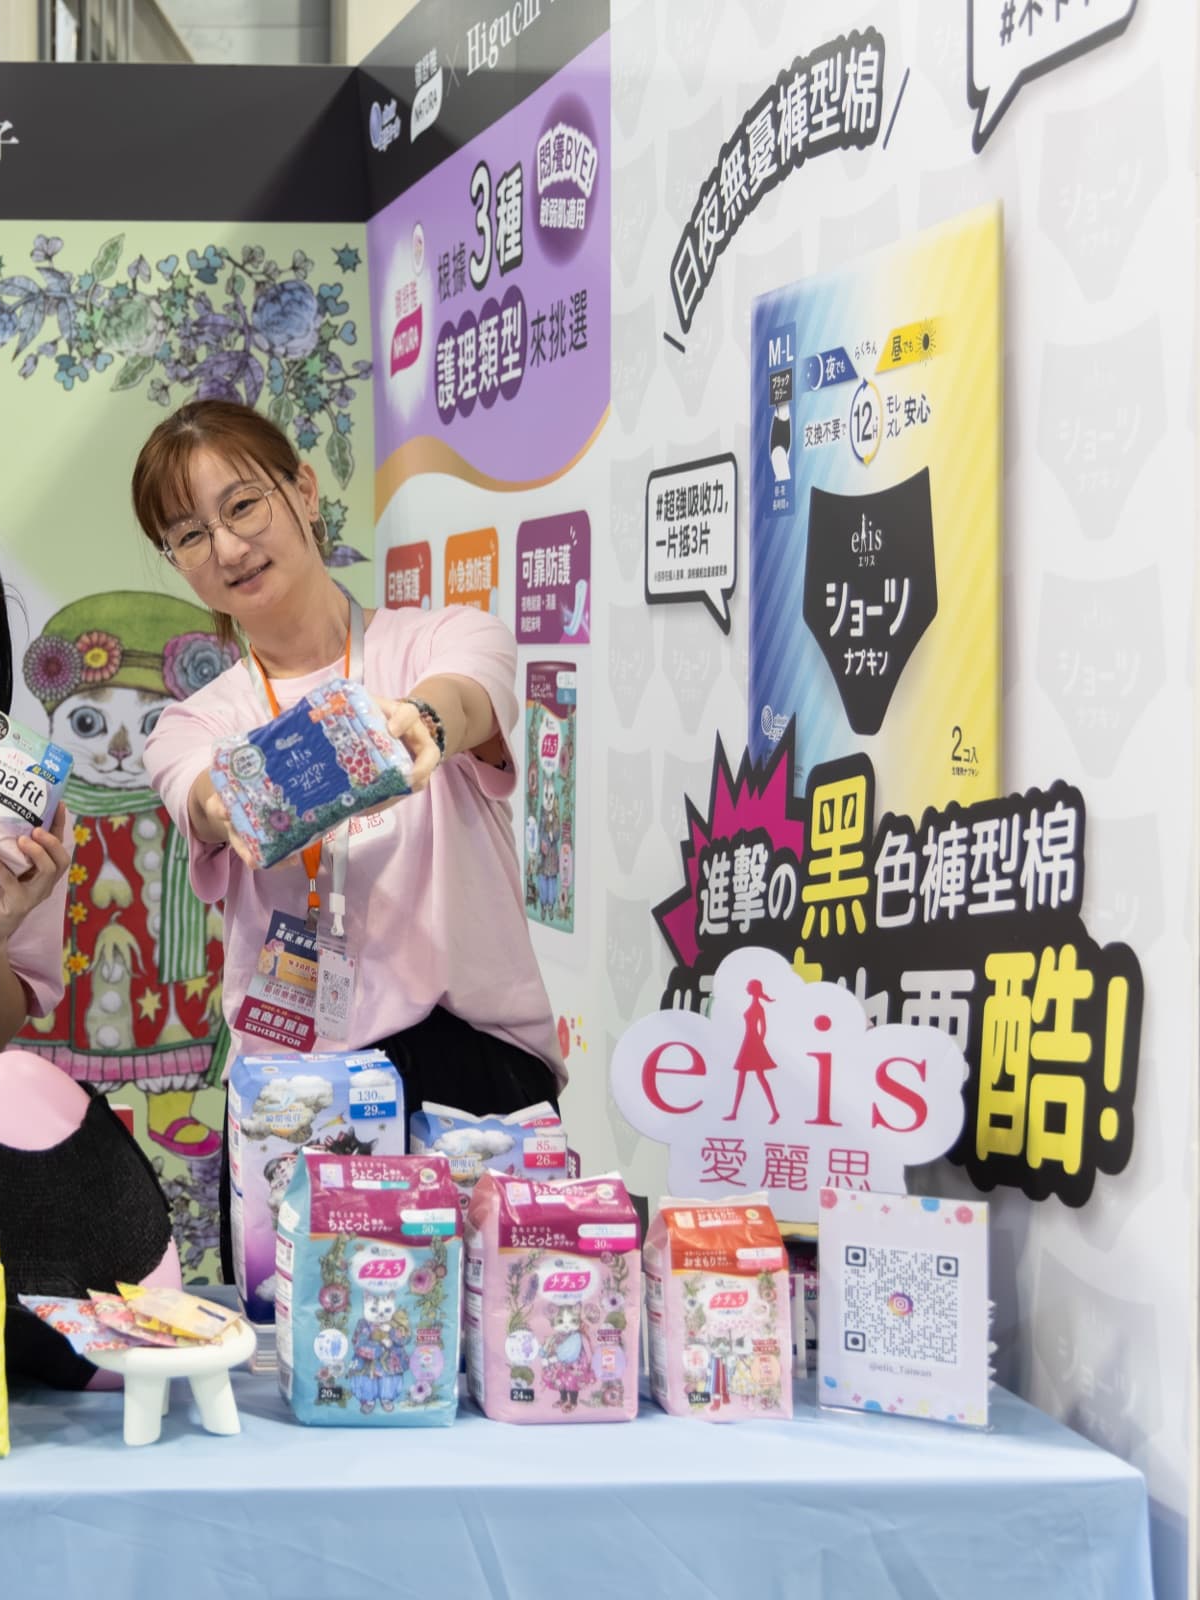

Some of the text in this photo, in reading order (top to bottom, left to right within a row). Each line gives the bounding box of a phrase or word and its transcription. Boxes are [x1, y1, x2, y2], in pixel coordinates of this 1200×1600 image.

[768, 335, 794, 368] M-L
[890, 335, 914, 362] 昼でも
[825, 356, 846, 380] 夜でも
[904, 393, 931, 426] 安心
[826, 577, 910, 637] ショーツ
[844, 648, 889, 677] ナプキン
[19, 779, 44, 807] fit
[701, 1136, 871, 1191] 愛麗思
[328, 1219, 370, 1232] ちょこっと
[511, 1235, 553, 1247] ちょこっと
[365, 1261, 404, 1277] ナチュラ
[550, 1275, 588, 1289] ナチュラ
